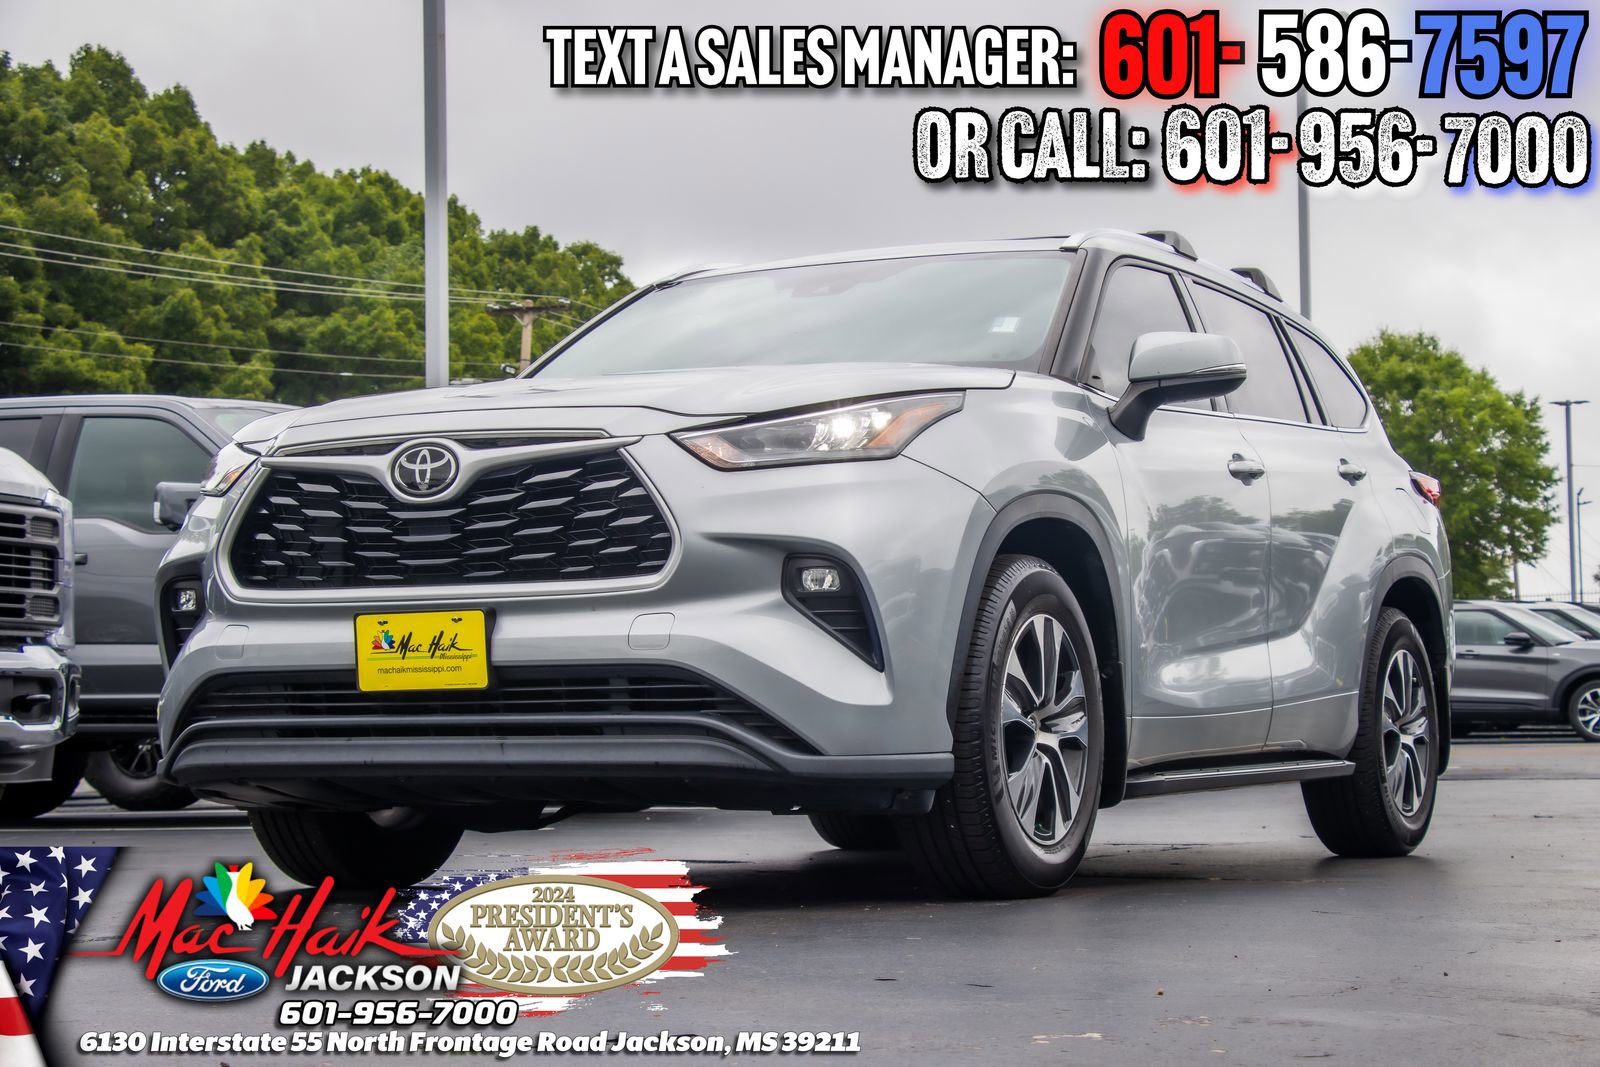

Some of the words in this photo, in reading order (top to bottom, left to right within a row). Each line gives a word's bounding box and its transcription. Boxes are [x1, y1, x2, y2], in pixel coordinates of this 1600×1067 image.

[396, 631, 427, 660] Mac
[428, 630, 472, 659] Haik
[377, 664, 462, 674] machaikmississippi.com
